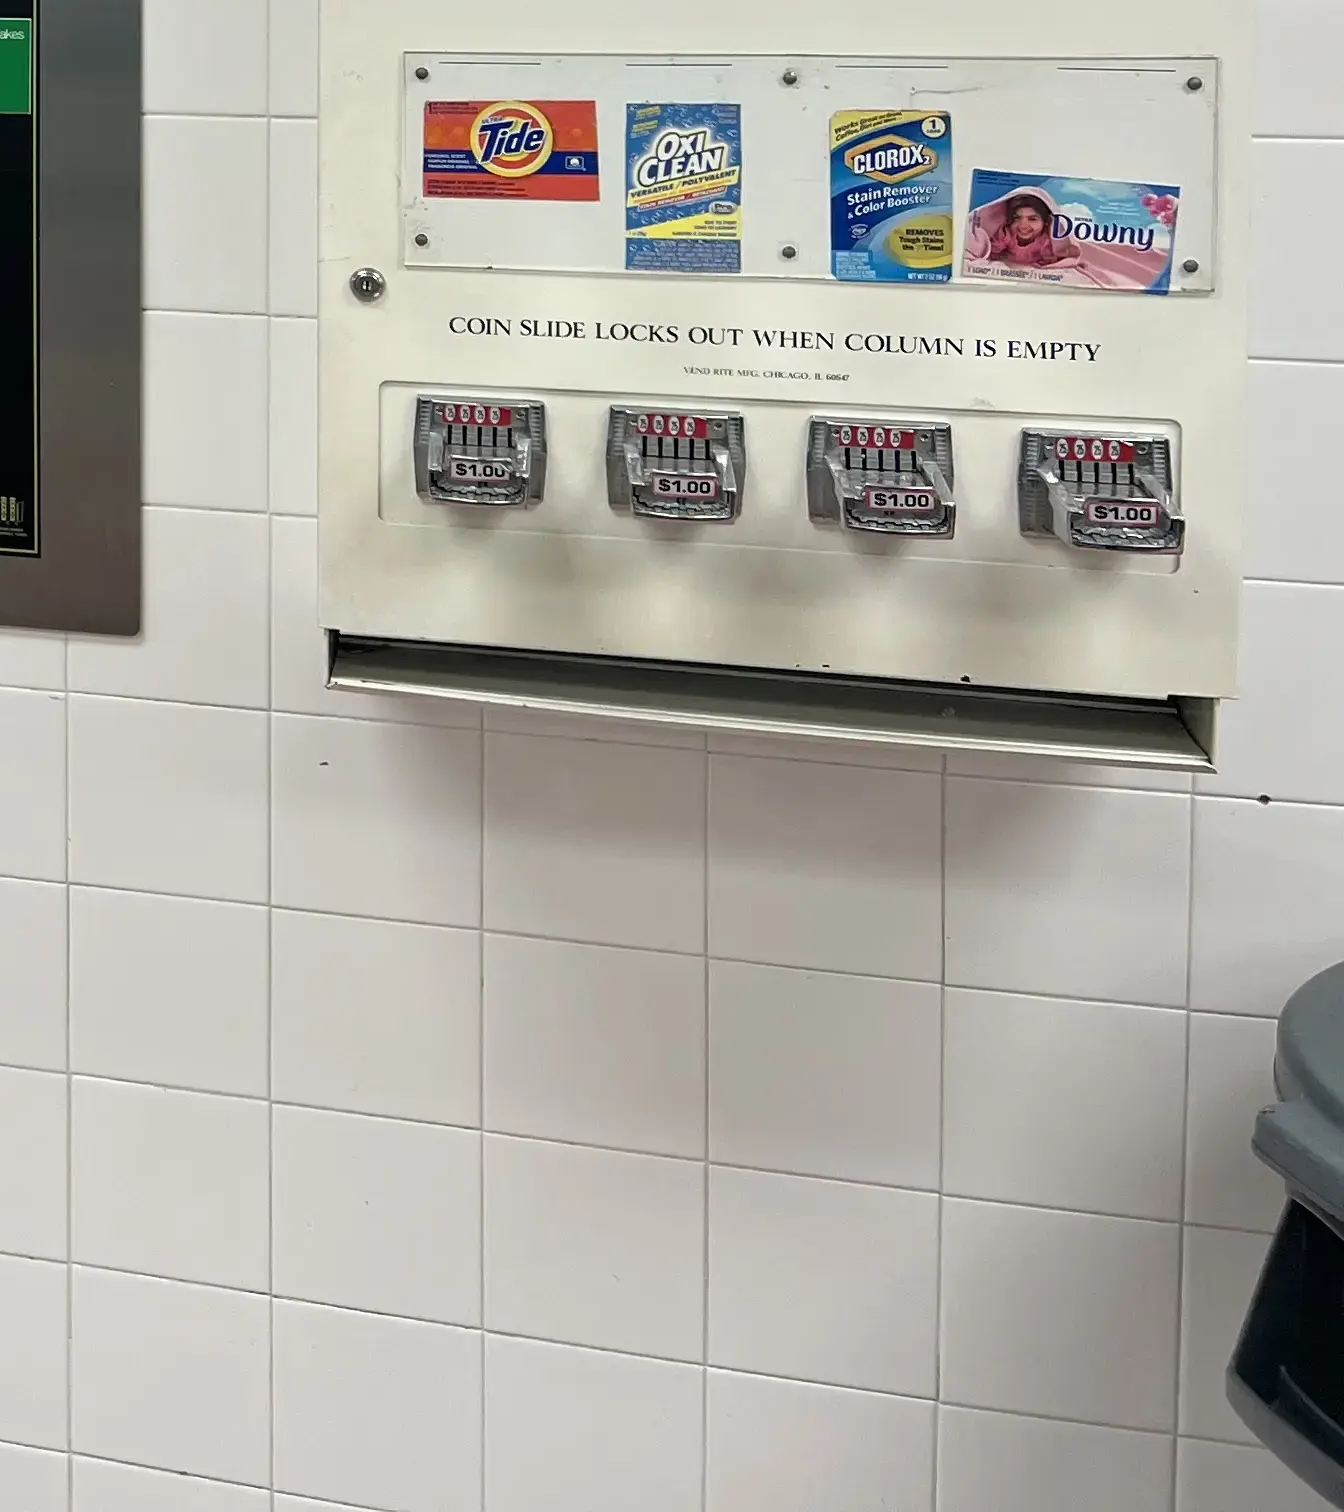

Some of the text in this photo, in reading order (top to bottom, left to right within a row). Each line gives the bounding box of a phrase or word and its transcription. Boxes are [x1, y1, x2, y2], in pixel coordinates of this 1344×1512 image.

[834, 121, 858, 134] Works
[929, 119, 936, 128] 1
[478, 120, 547, 165] Tide
[656, 130, 706, 162] OXI
[638, 147, 724, 187] CLEAN
[631, 183, 674, 197] VERSATILE
[682, 169, 737, 187] POLYVALENT
[847, 185, 939, 206] Stain Remover
[854, 201, 885, 216] Color
[887, 195, 931, 208] Booster
[899, 236, 921, 244] Tough
[1052, 213, 1154, 251] Downy
[449, 316, 1102, 362] COIN SLIDE LOCKS OUT WHEN COLUMN IS EMPTY
[683, 366, 711, 375] VEND
[713, 368, 734, 377] RITE
[455, 463, 506, 478] $1.00
[658, 478, 711, 494] $1.00
[874, 493, 929, 507] $1.00
[1094, 505, 1152, 521] $1.00
